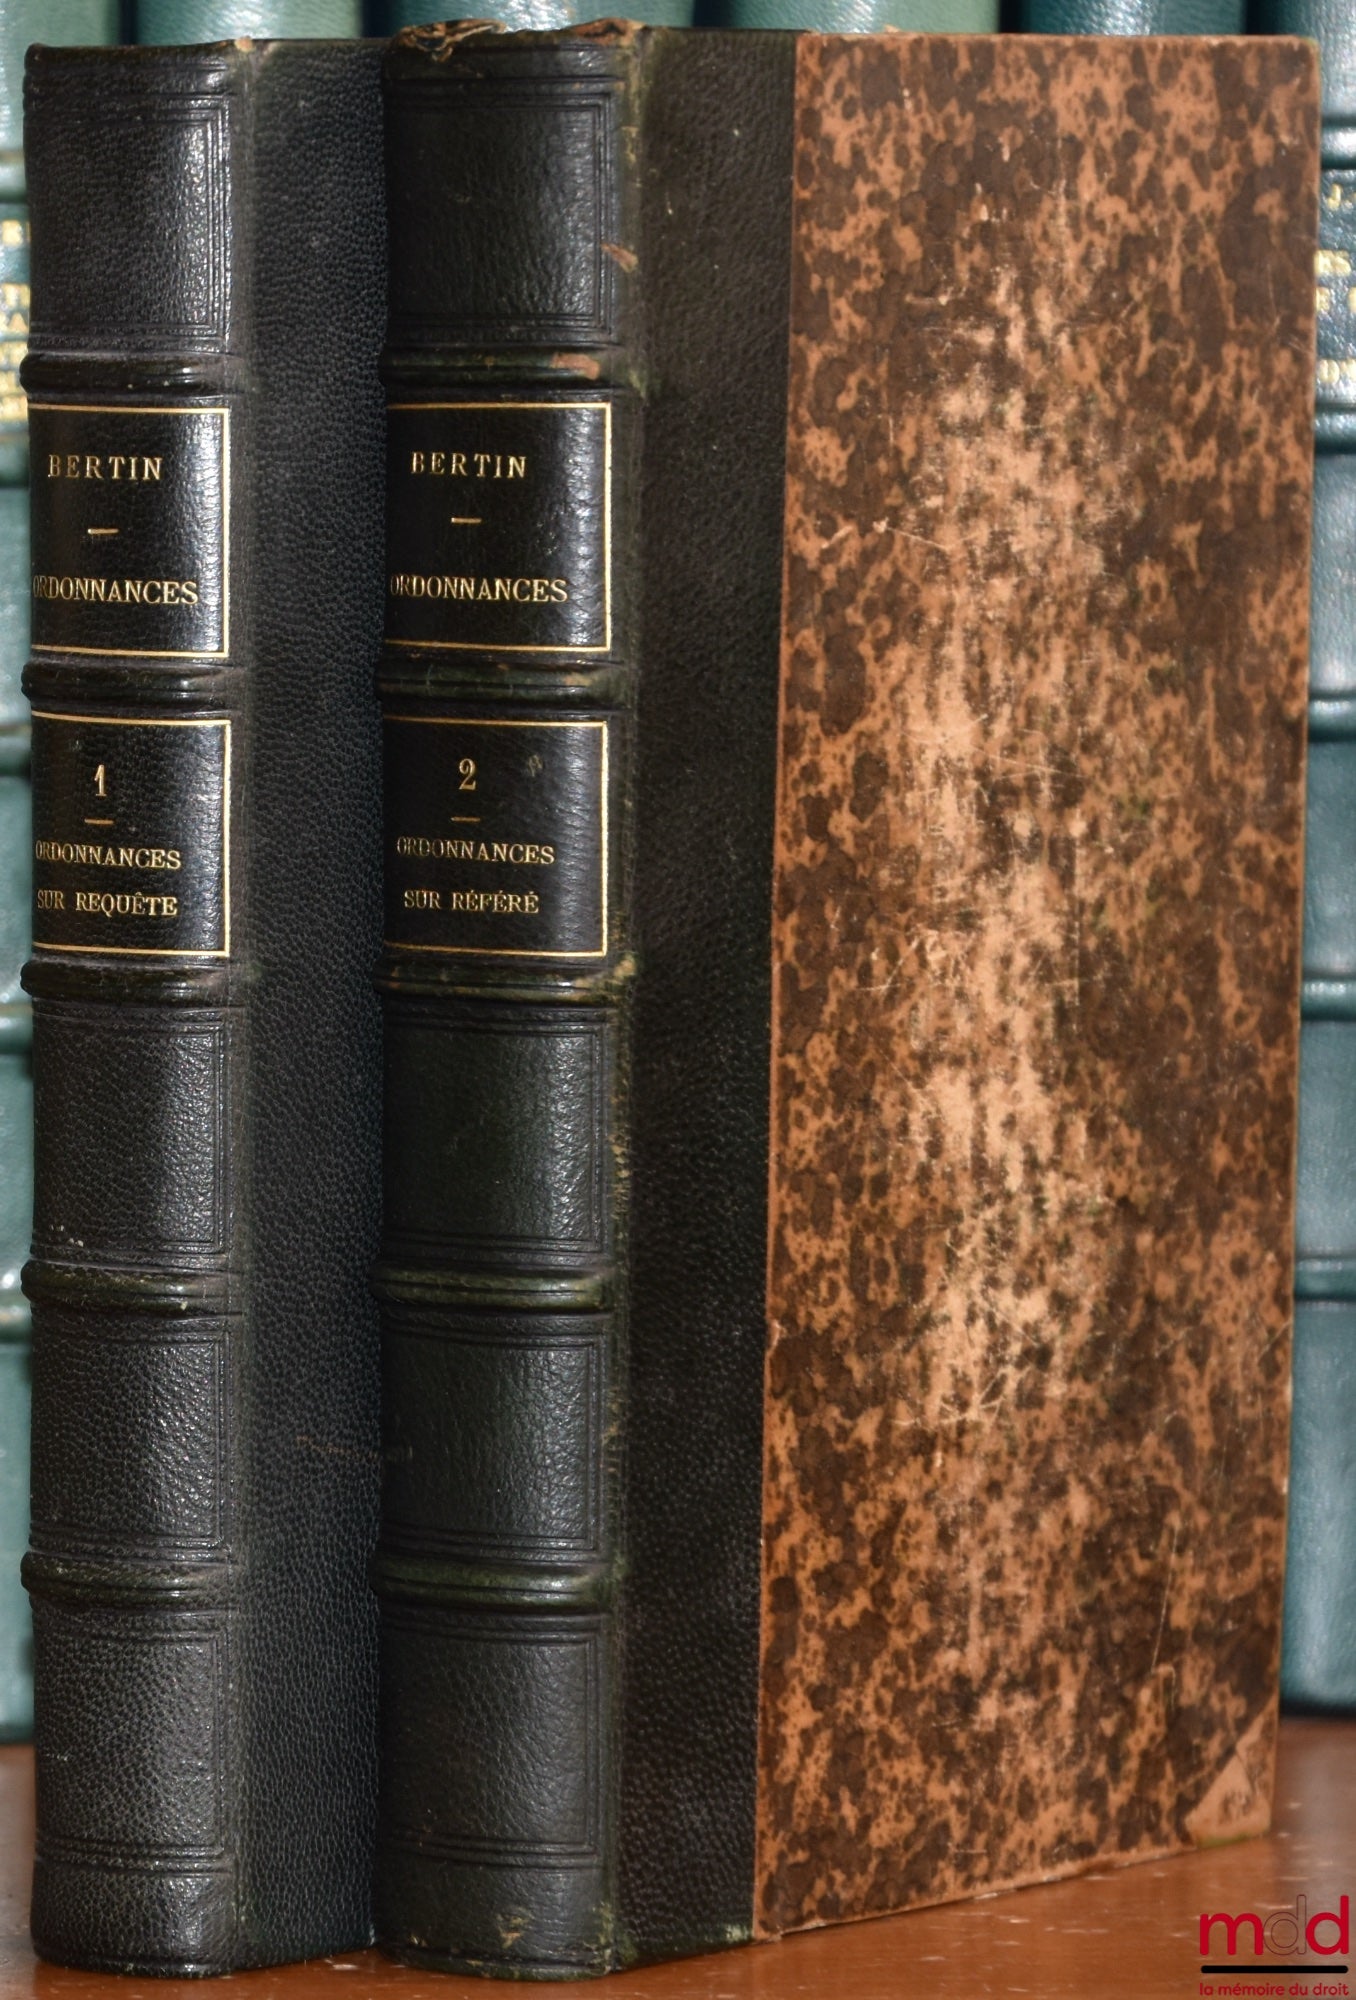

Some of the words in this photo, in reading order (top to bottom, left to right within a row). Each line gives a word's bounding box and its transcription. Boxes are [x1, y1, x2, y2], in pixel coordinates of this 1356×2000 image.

[48, 454, 163, 480] BERTIN
[411, 451, 527, 479] BERTIN
[33, 575, 199, 605] ORDONNANCES
[390, 574, 568, 603] ORDONNANCES
[94, 764, 107, 797] 1
[458, 758, 476, 790] 2
[35, 840, 181, 870] ORDONNANCES
[396, 836, 555, 865] ORDONNANCES
[37, 889, 65, 910] SUR
[75, 891, 178, 918] REQUÊTE
[404, 890, 441, 909] SUR
[452, 889, 539, 914] RÉFÉRÉ
